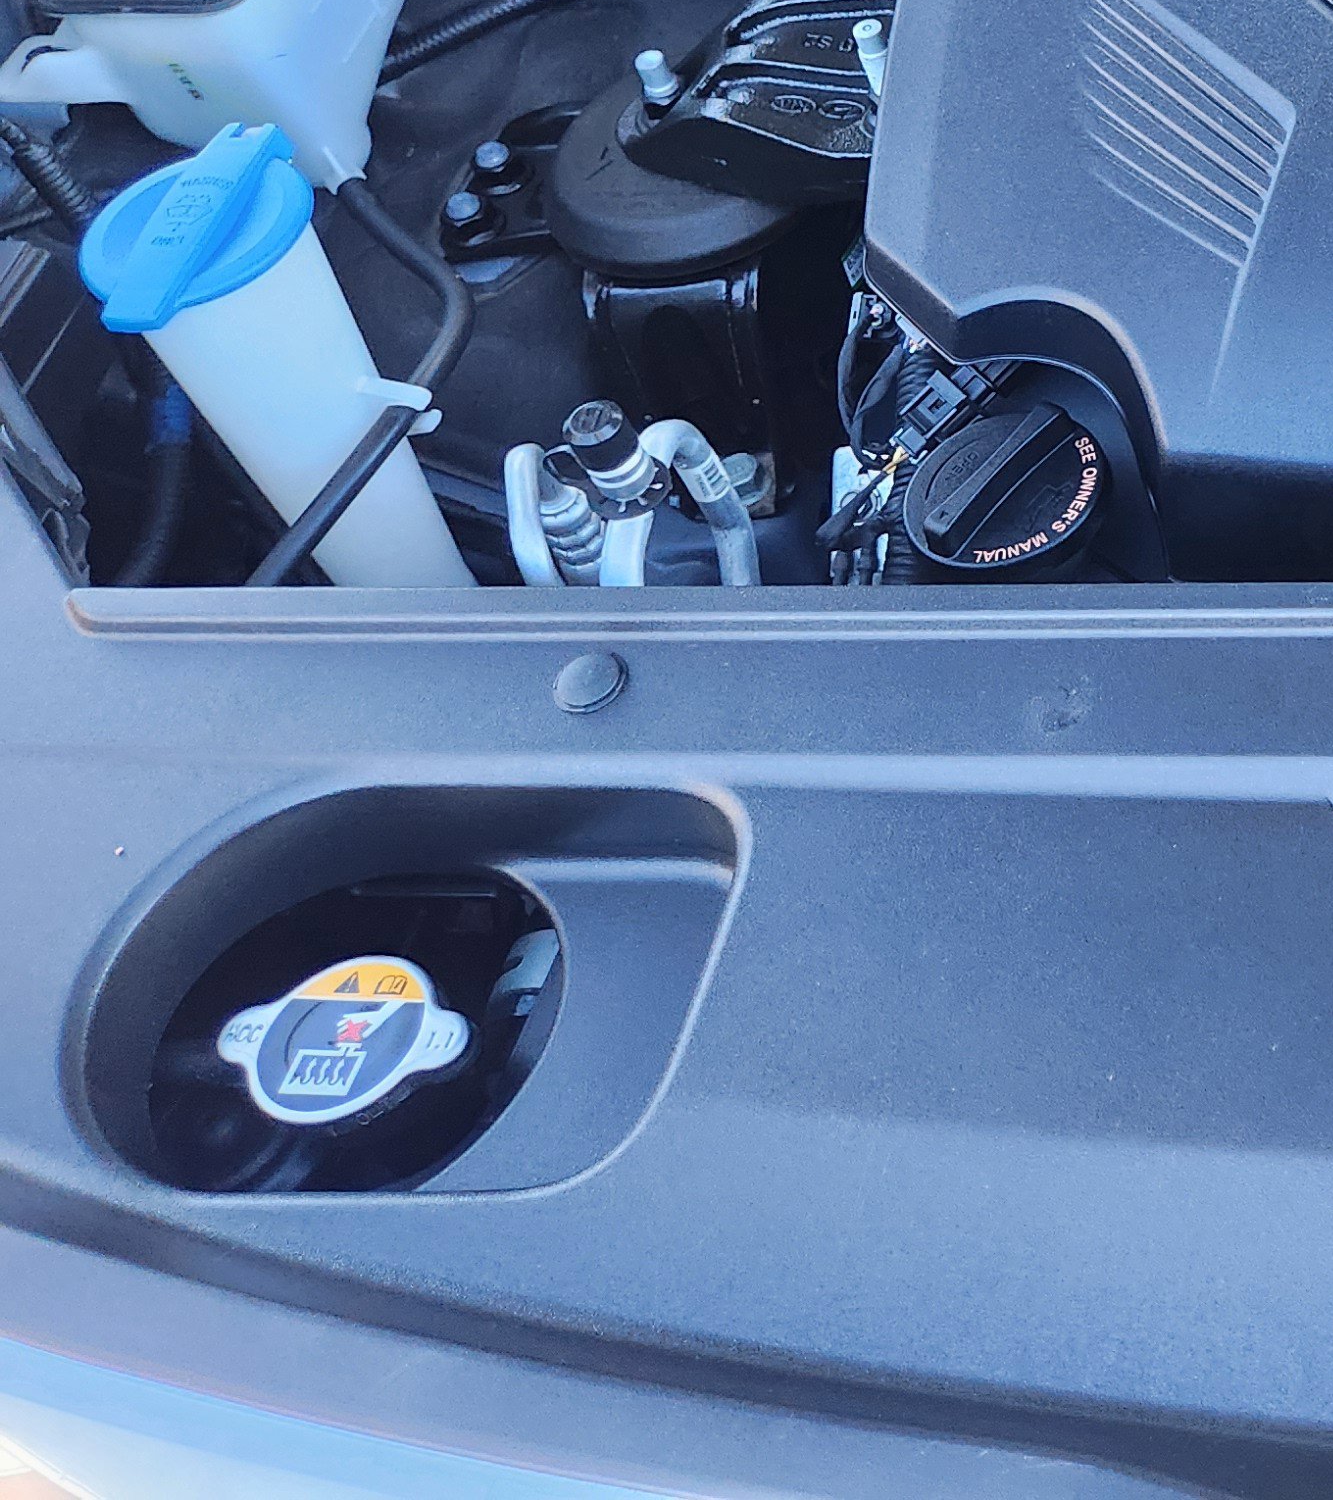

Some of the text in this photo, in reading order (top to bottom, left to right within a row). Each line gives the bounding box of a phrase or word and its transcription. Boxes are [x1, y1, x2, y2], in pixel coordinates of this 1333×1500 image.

[973, 436, 1098, 563] SEE OWNER'S MANUAL
